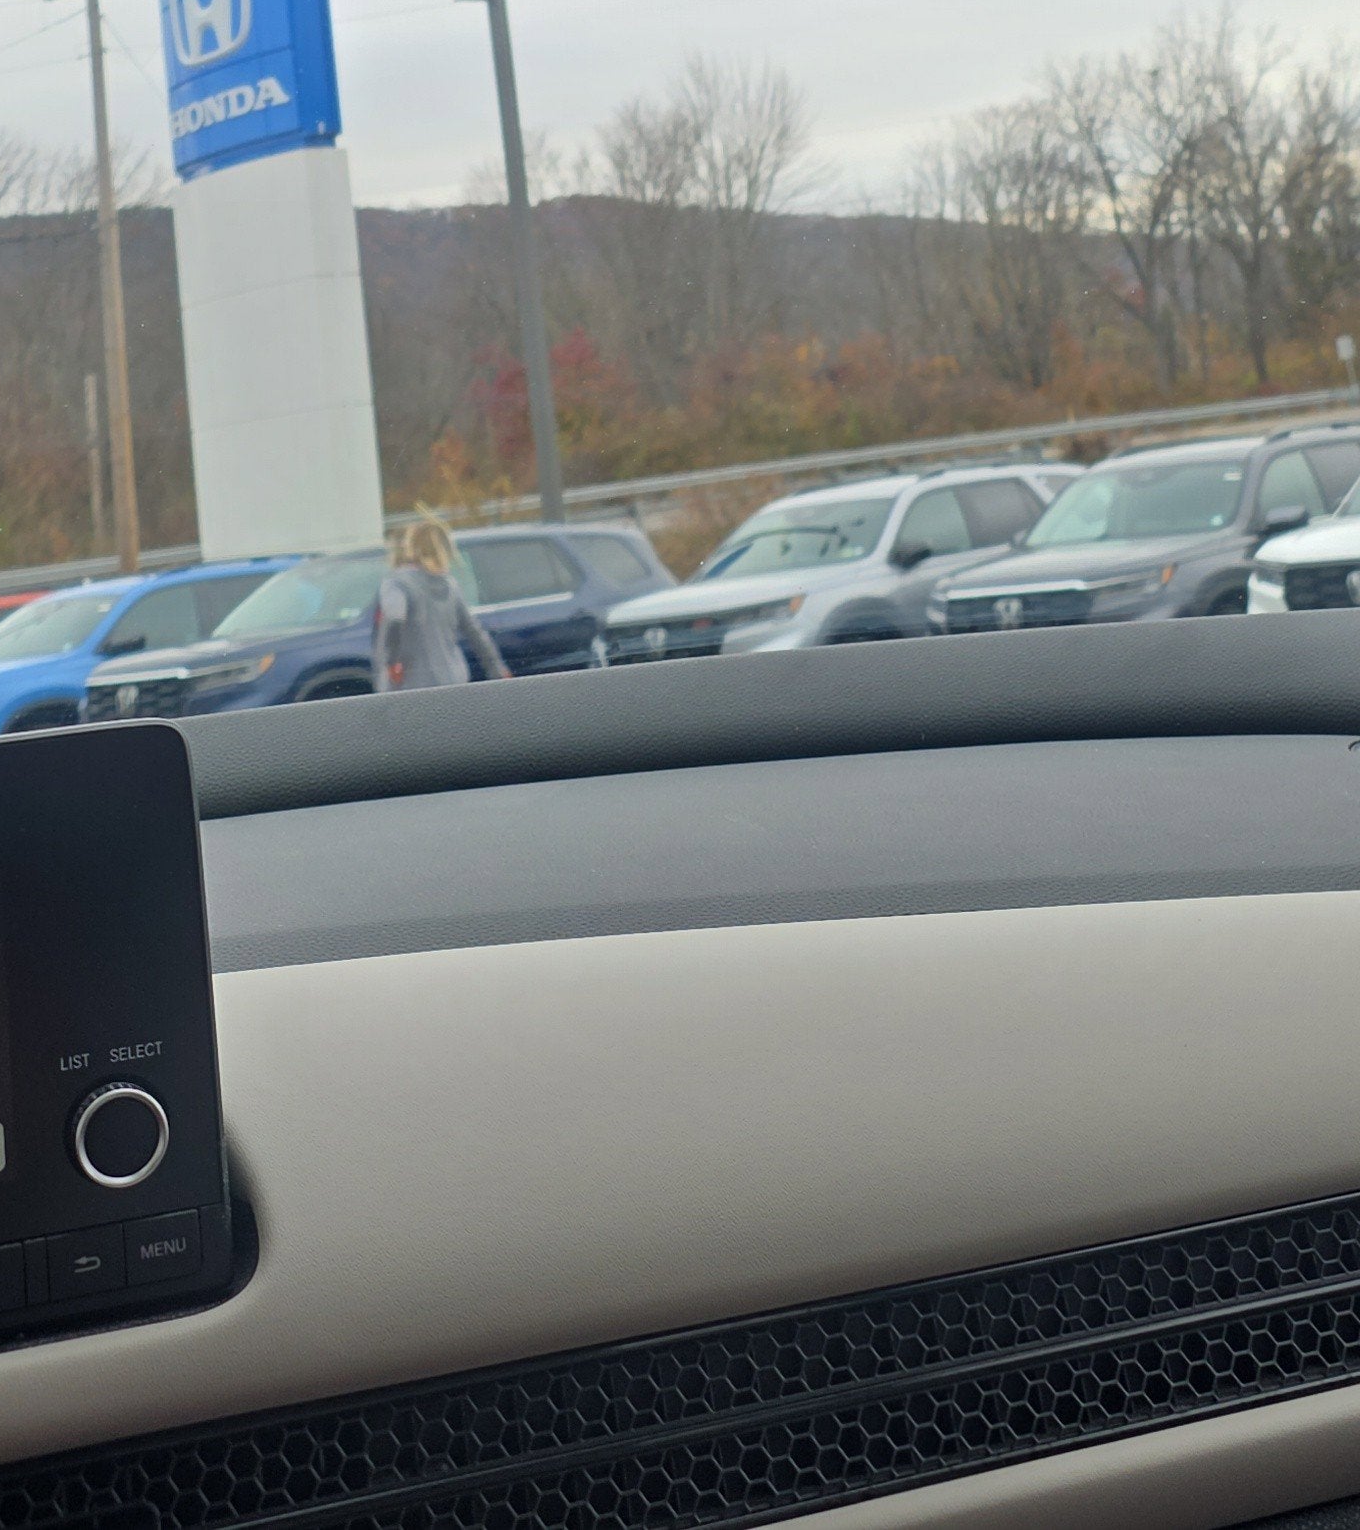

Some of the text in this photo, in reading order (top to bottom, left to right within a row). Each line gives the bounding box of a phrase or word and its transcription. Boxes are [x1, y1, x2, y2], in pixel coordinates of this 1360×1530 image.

[59, 1053, 90, 1071] LIST
[109, 1041, 164, 1063] SELECT
[140, 1236, 187, 1260] MENU
